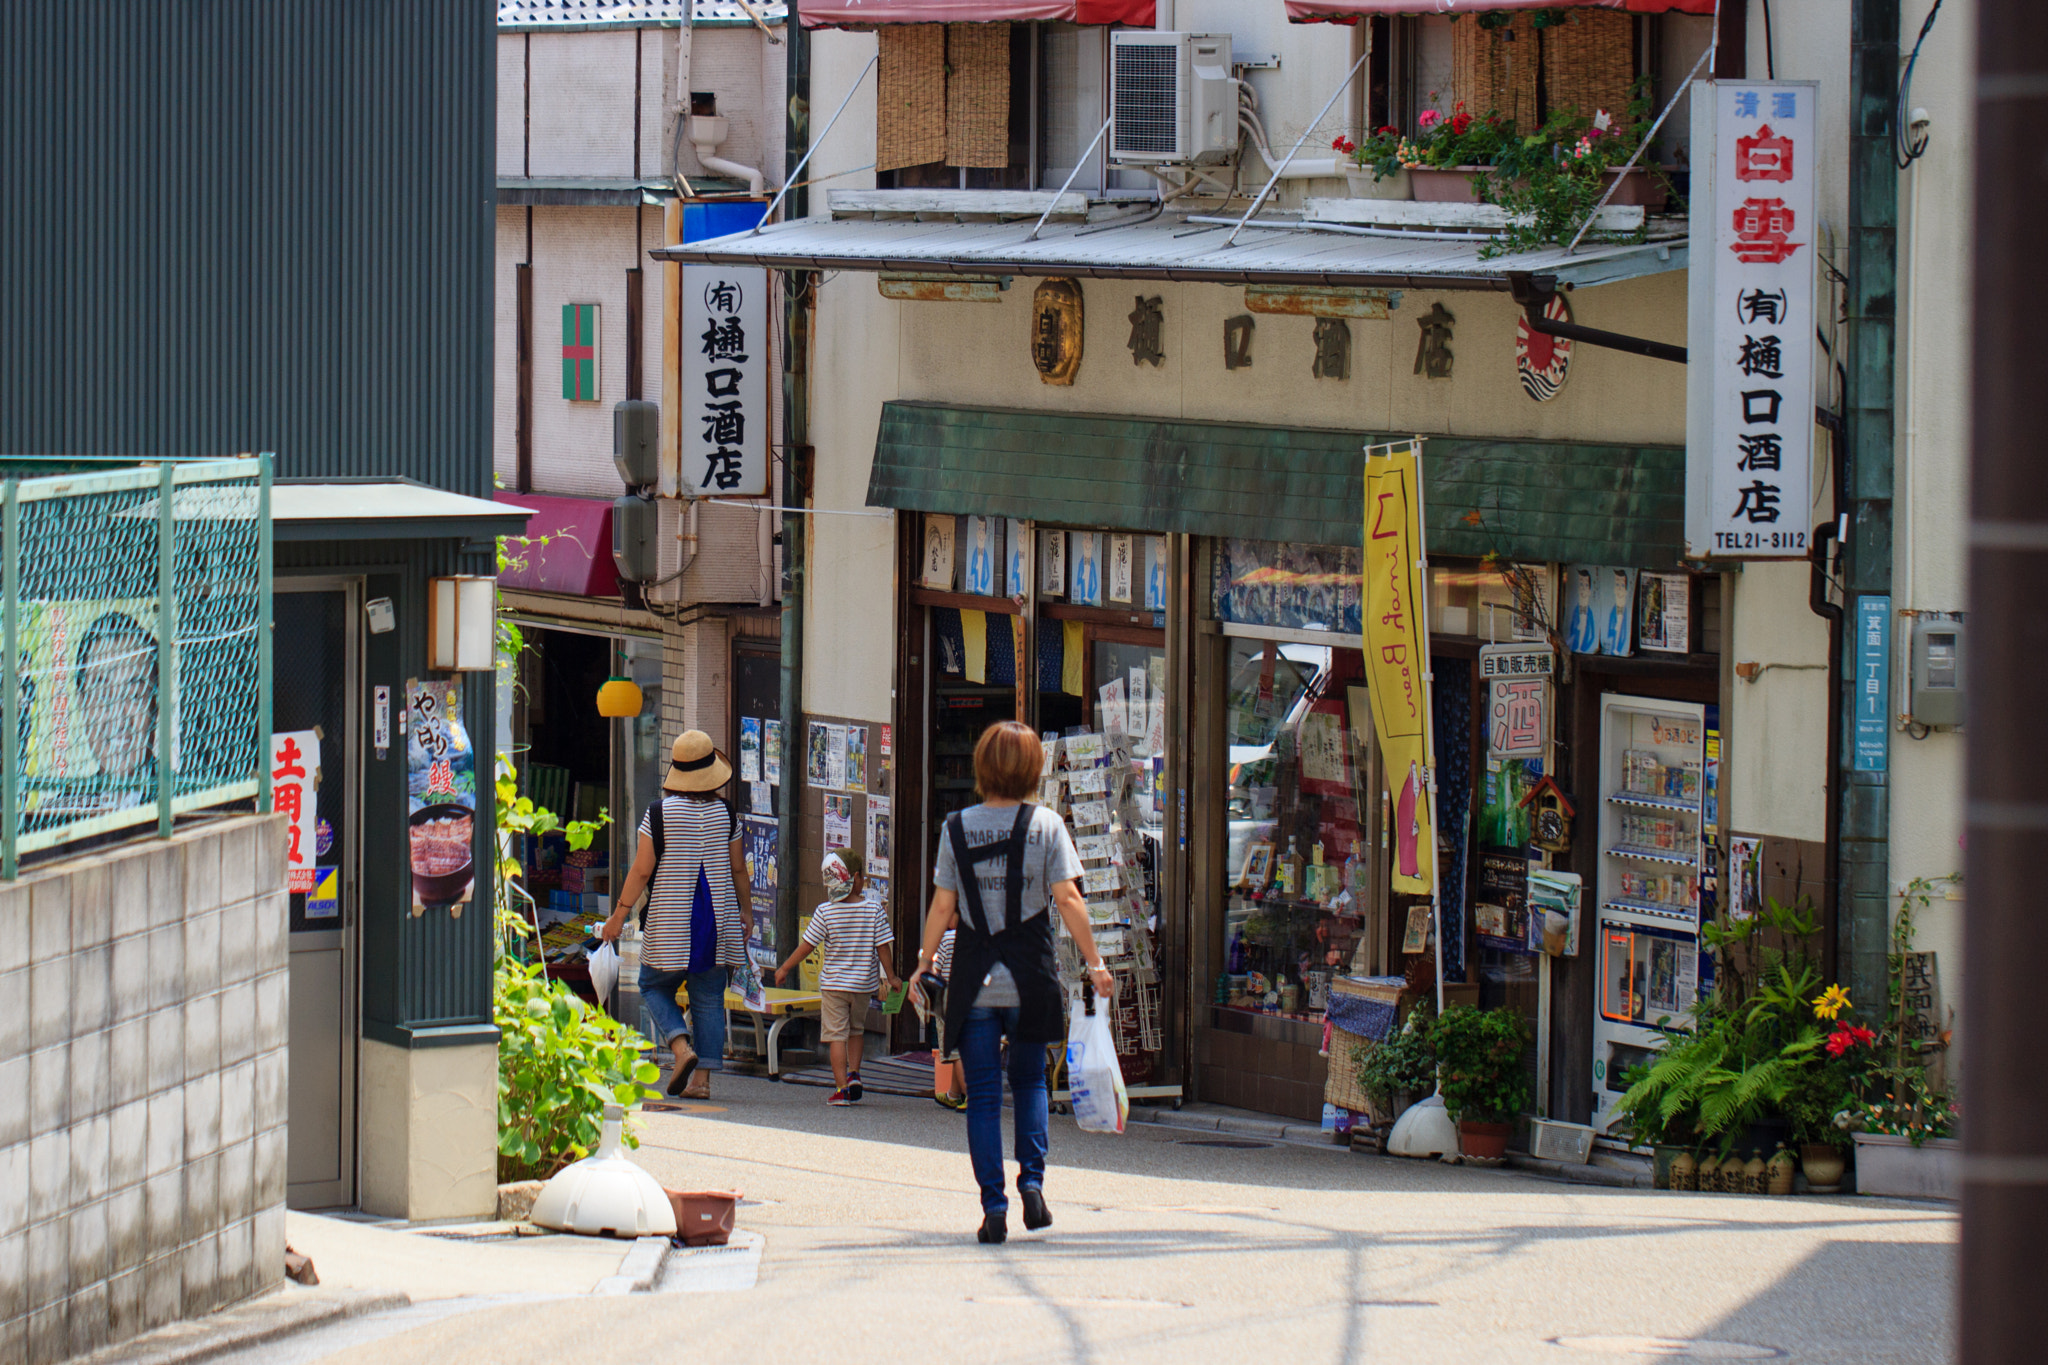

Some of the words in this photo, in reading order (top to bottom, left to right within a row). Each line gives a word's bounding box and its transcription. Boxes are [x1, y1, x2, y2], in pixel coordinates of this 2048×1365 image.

[1734, 91, 1797, 119] 清酒
[1729, 123, 1806, 264] 白雪
[1484, 655, 1551, 675] 自動販売機
[1494, 681, 1543, 752] 酒
[427, 760, 457, 796] 鰻
[307, 901, 336, 910] ALSOK
